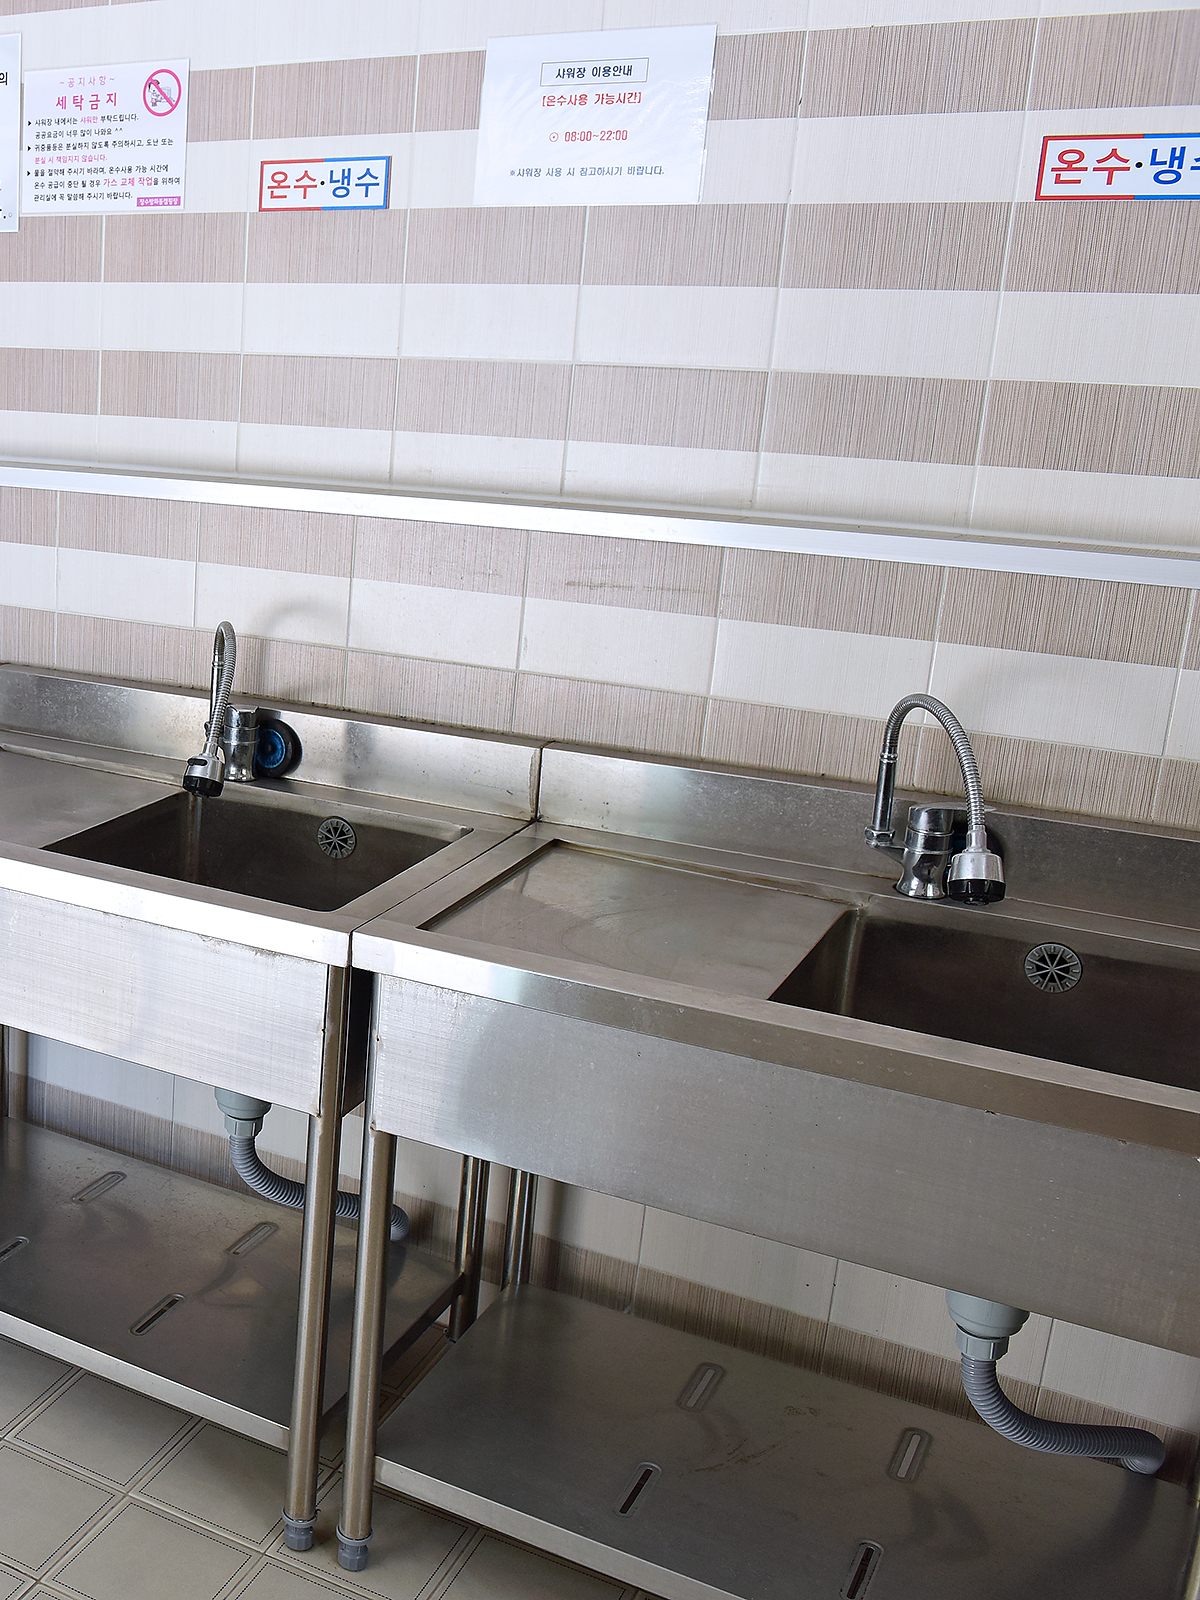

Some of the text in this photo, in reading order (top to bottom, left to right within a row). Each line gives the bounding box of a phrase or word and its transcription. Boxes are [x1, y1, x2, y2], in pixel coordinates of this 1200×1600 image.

[556, 64, 632, 80] 샤워장 이용안내
[542, 92, 642, 107] [온수사용 가능시간]
[564, 130, 628, 142] 08:00~22:00
[546, 167, 562, 176] 사용
[567, 166, 575, 176] 시
[1051, 146, 1200, 186] 온수·냉
